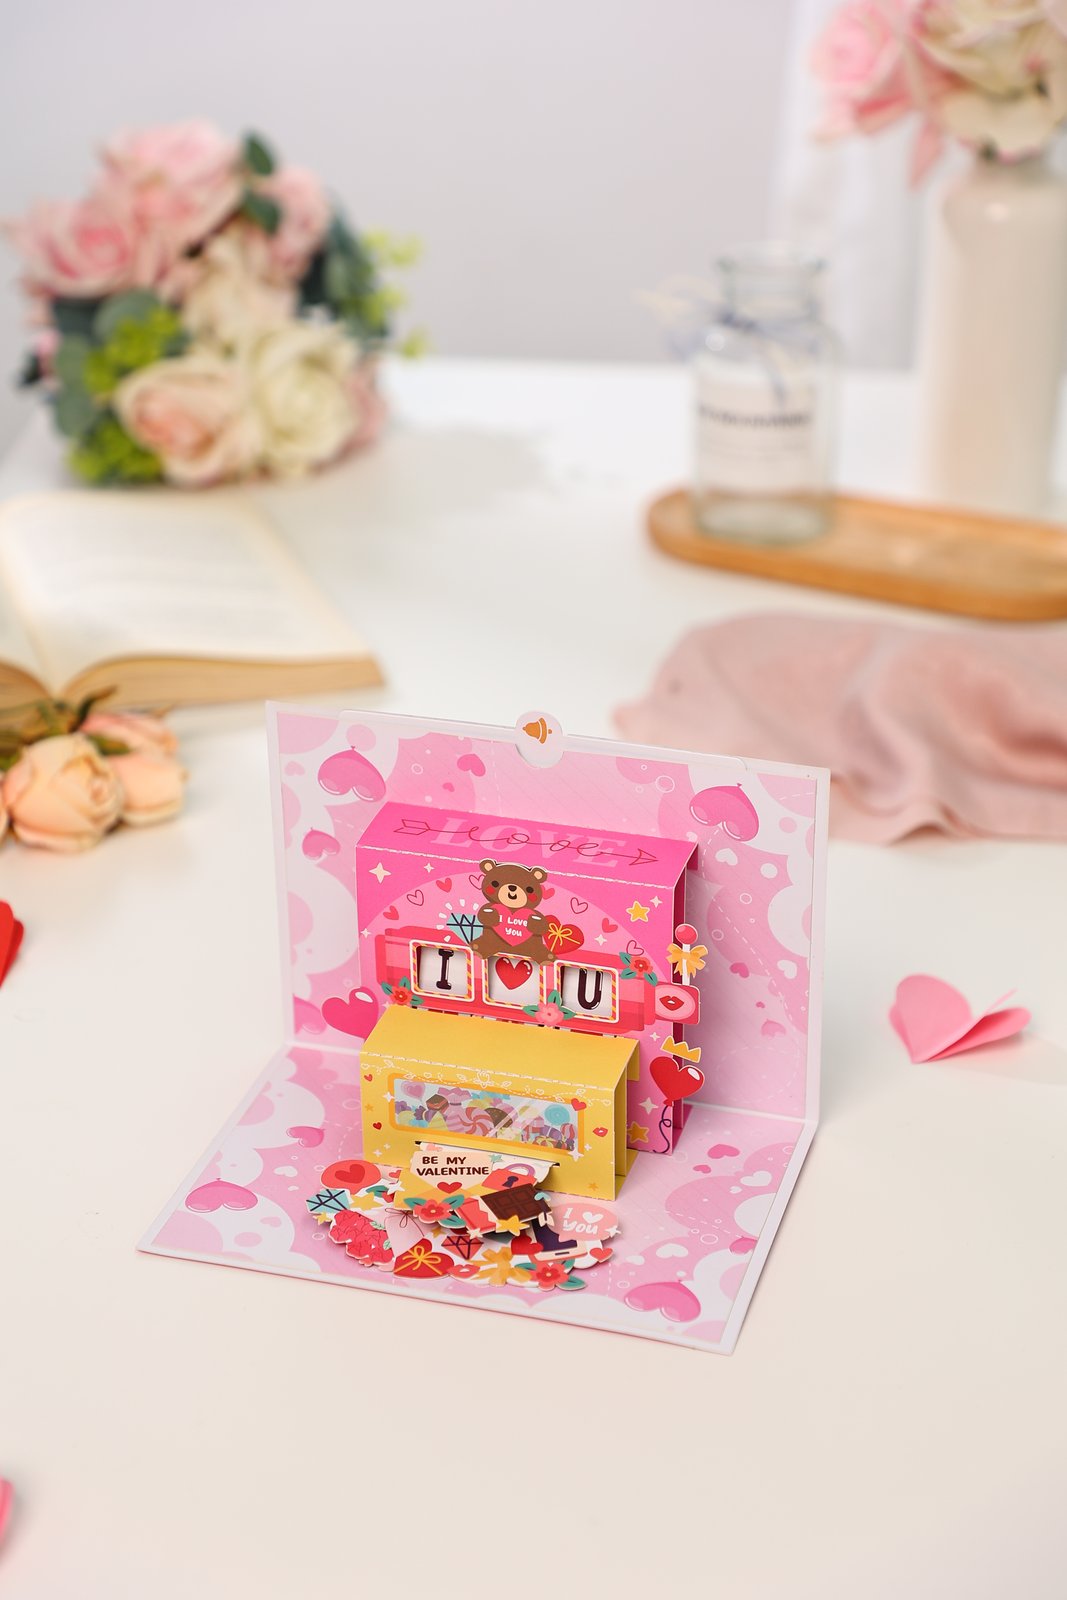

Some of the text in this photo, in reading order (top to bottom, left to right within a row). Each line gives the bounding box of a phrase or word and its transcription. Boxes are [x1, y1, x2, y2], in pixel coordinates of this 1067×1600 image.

[430, 816, 626, 868] LOVE
[436, 948, 605, 1011] I U
[422, 1156, 466, 1165] BE MY
[416, 1166, 490, 1176] VALENTINE
[563, 1207, 574, 1219] I
